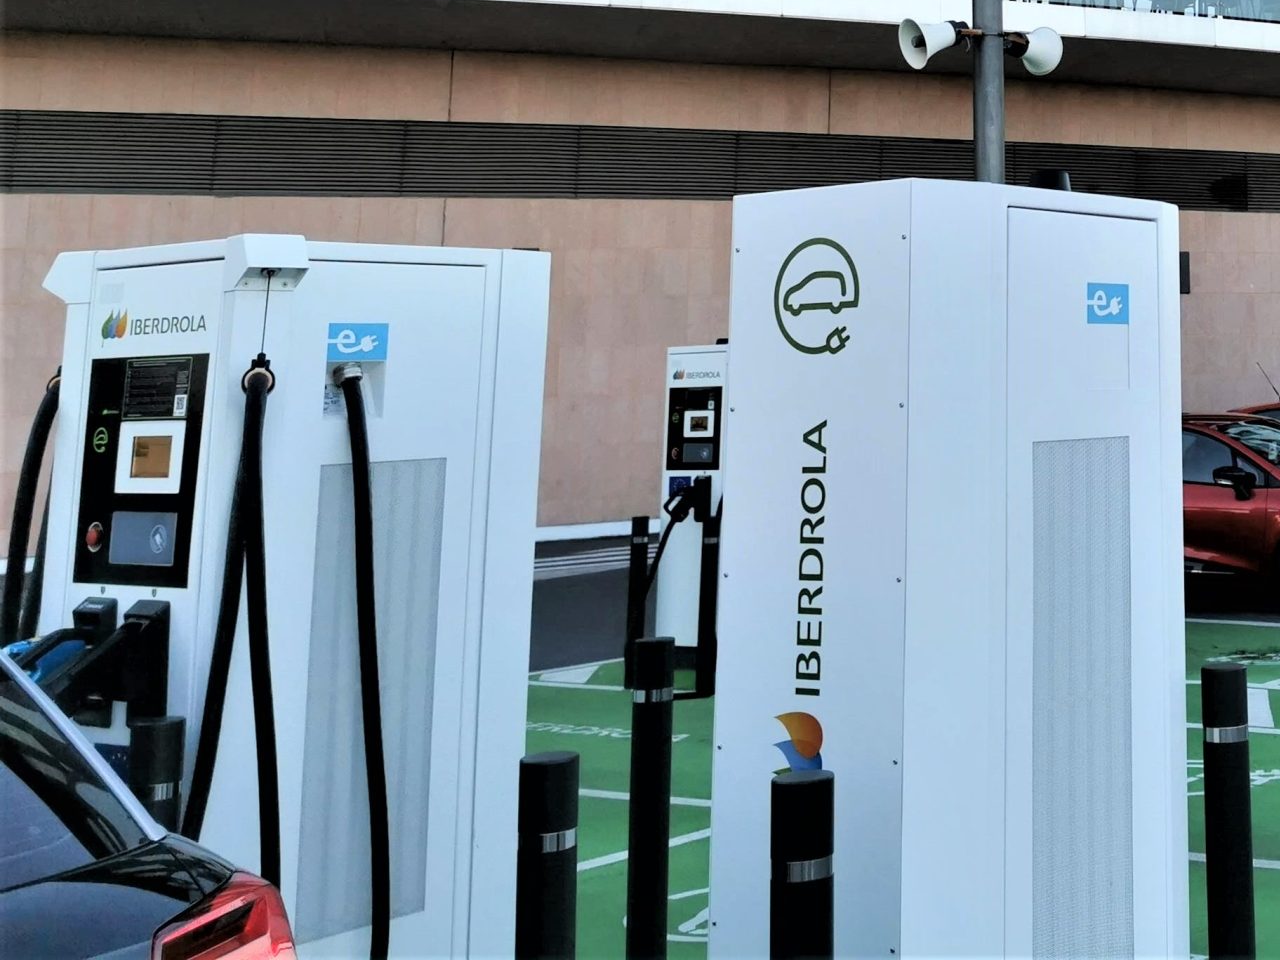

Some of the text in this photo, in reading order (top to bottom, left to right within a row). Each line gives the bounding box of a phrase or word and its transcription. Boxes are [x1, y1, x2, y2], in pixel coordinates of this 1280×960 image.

[129, 315, 207, 336] IBERDROLA
[686, 370, 721, 380] IBERDROLA
[795, 419, 828, 696] IBERDROLA
